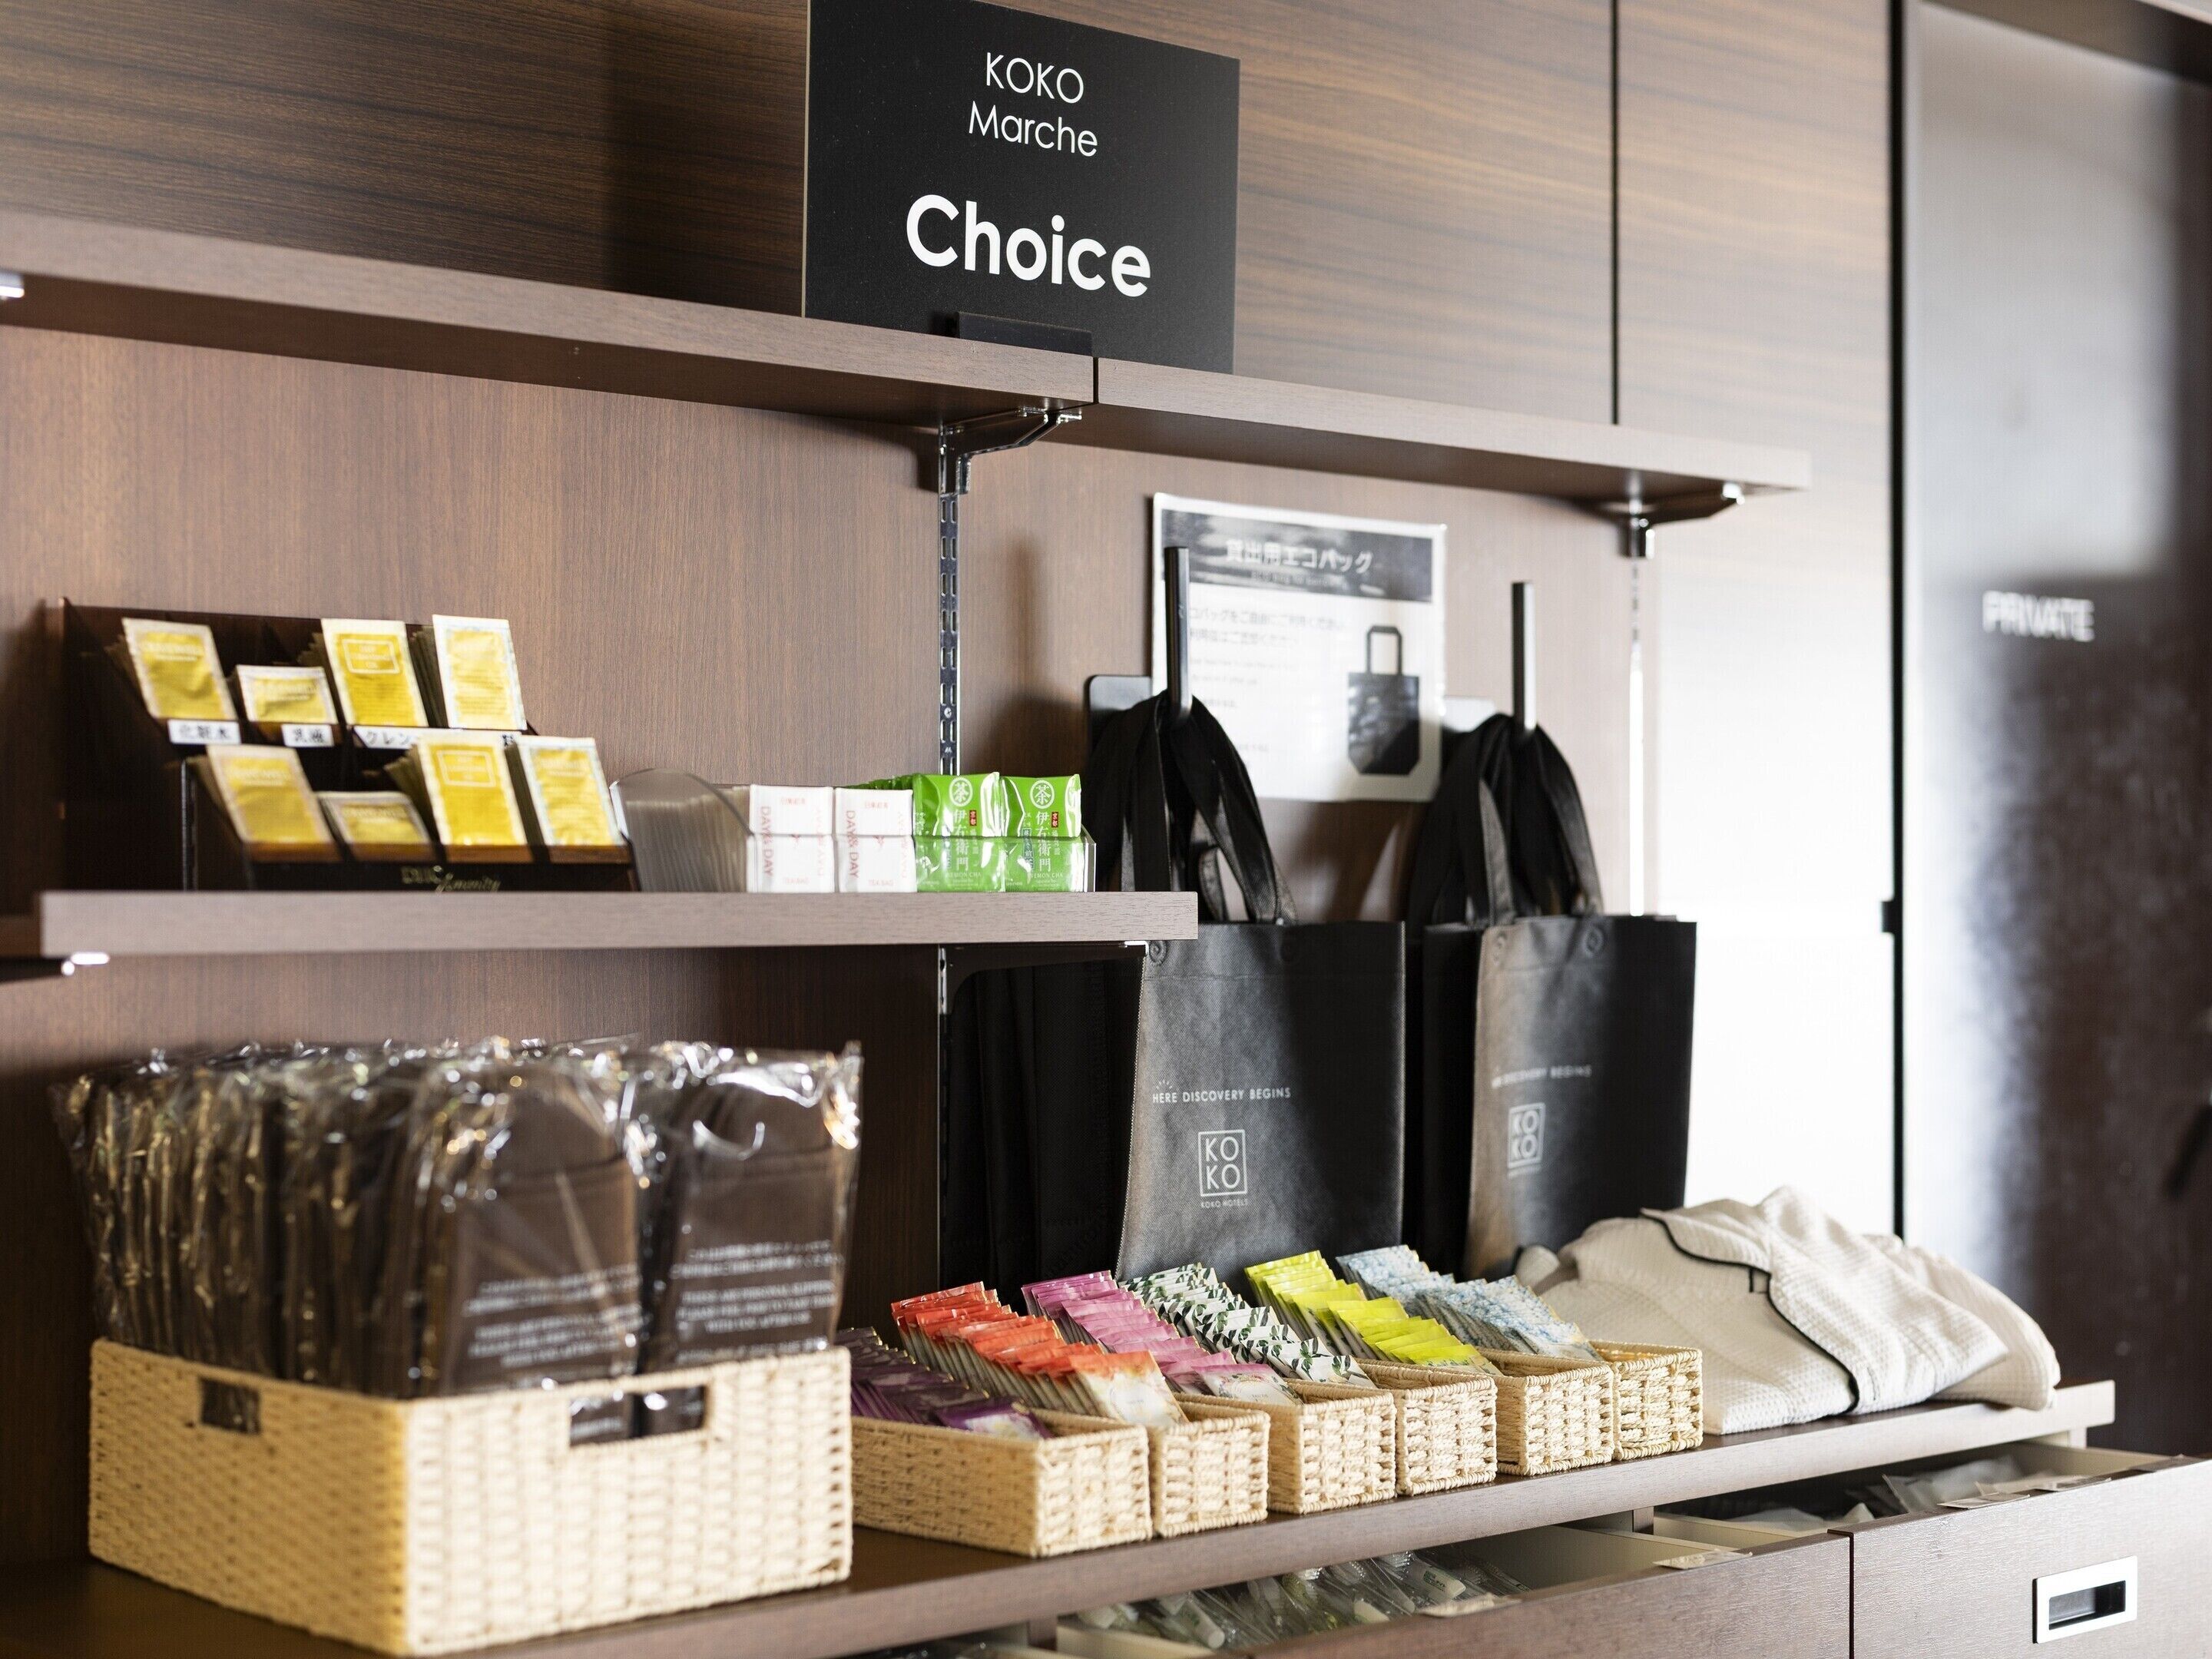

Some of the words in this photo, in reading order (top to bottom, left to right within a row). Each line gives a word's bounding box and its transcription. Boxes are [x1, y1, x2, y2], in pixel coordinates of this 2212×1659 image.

[985, 51, 1084, 104] KOKO
[969, 101, 1098, 157] Marche
[906, 194, 1151, 297] Choice
[1226, 539, 1374, 574] 貸出用エコバッグ
[1982, 591, 2094, 642] PRIVATE
[365, 730, 416, 746] クレン
[953, 780, 969, 803] 茶
[1034, 784, 1051, 805] 茶
[846, 810, 857, 836] DAY
[1035, 811, 1052, 872] 伊右衛門
[849, 852, 859, 878] DAY
[1152, 1092, 1177, 1104] HERE
[1182, 1089, 1245, 1103] DISCOVERY
[1249, 1087, 1292, 1101] BEGINS
[1204, 1135, 1240, 1163] KO
[1204, 1163, 1241, 1190] KO
[1200, 1200, 1221, 1209] KOKO
